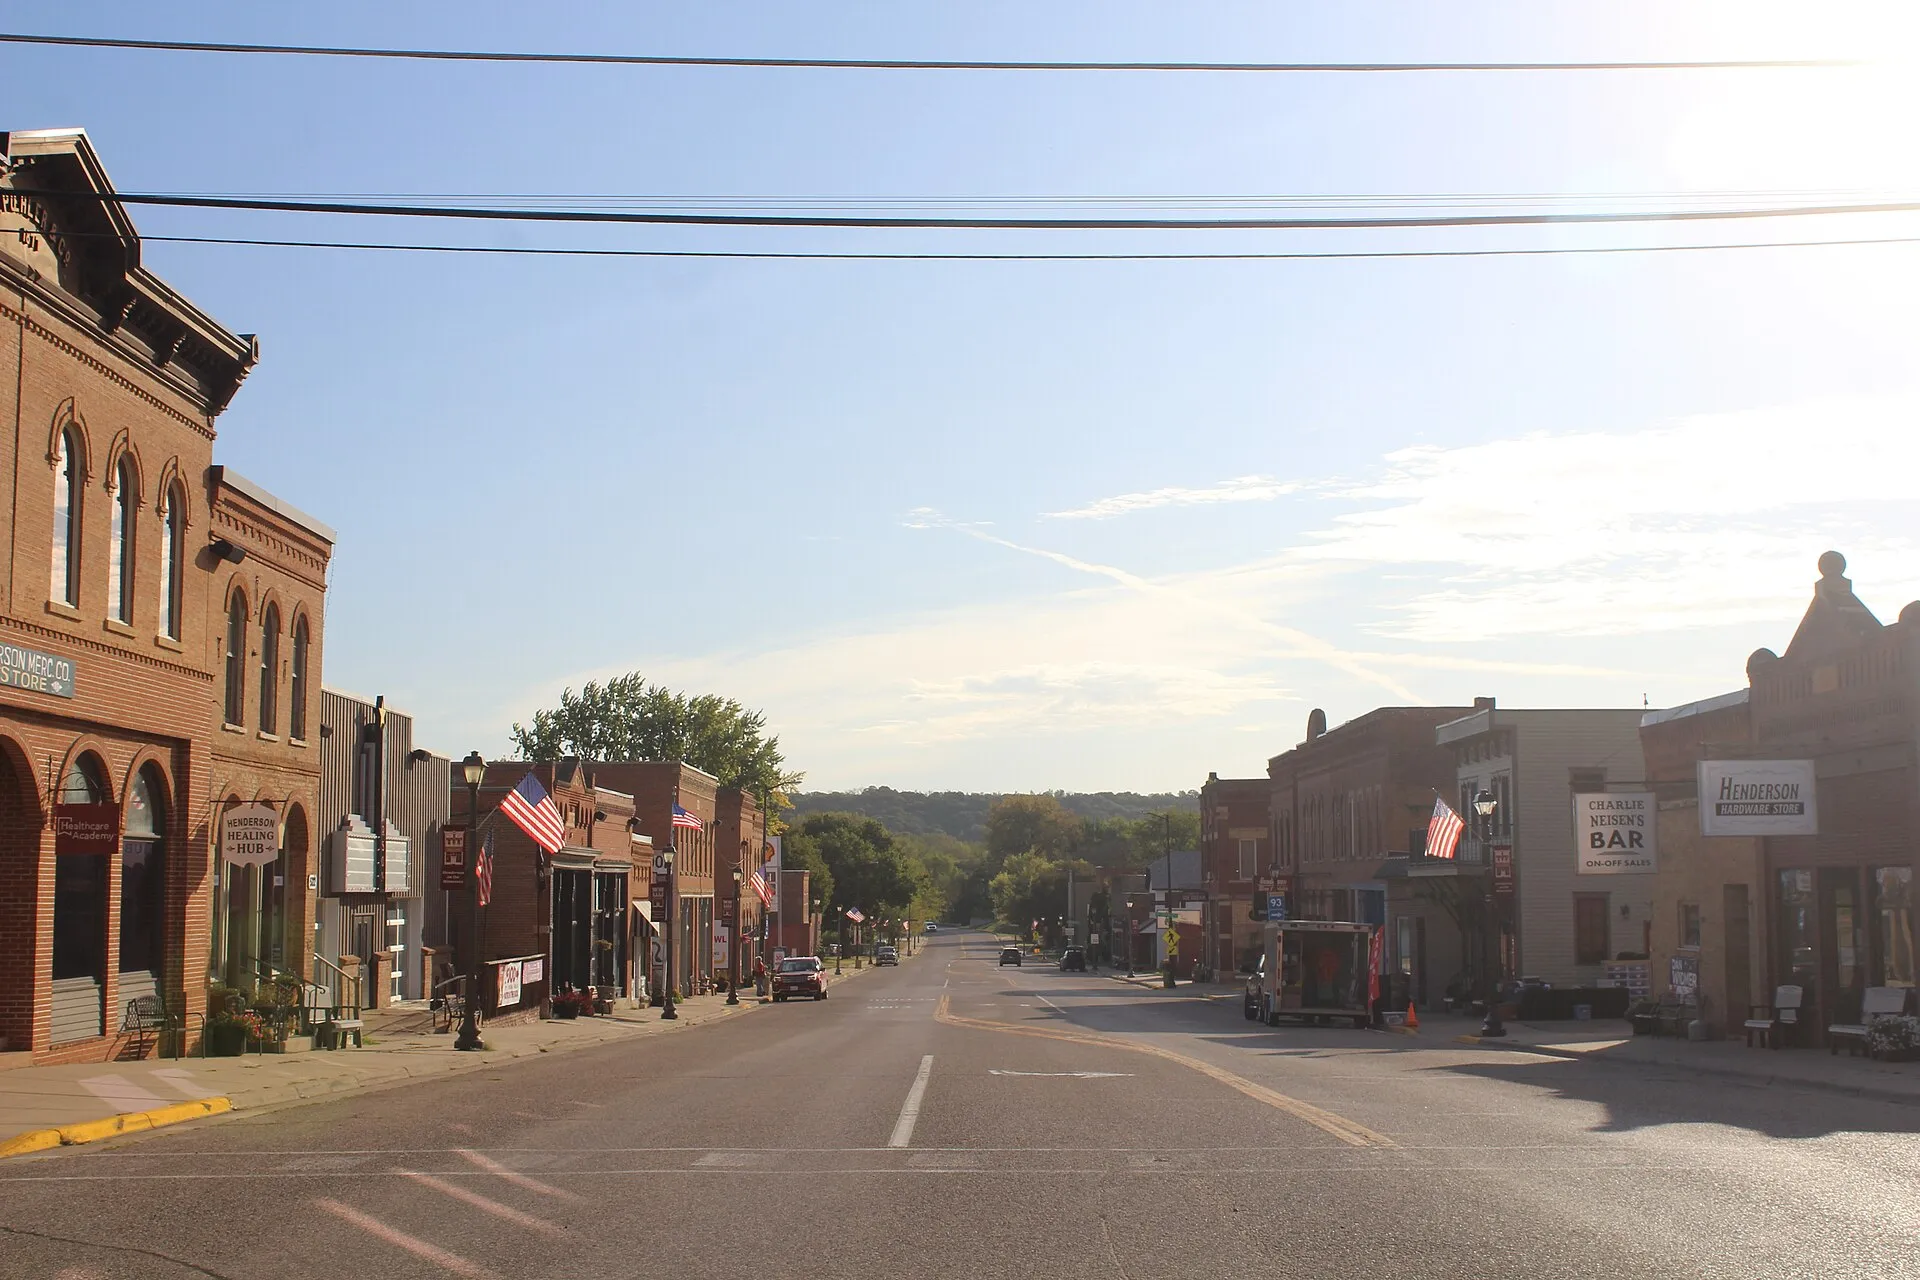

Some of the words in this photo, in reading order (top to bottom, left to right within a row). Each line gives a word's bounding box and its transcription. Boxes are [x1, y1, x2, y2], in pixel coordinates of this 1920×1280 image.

[28, 652, 54, 677] MERC.
[55, 661, 71, 682] CO.
[0, 666, 47, 691] STORE
[1720, 777, 1799, 800] HENDERSON
[1589, 800, 1645, 810] CHARLIE
[1721, 803, 1771, 815] HARDWARE
[1772, 803, 1800, 814] STORE
[61, 821, 110, 831] Healthcare
[227, 817, 275, 828] HENDERSON
[1590, 814, 1645, 827] NEISEN'S
[72, 831, 114, 842] Academy
[227, 831, 274, 841] HEALING
[1590, 829, 1645, 849] BAR
[236, 843, 264, 853] HUB
[1586, 860, 1623, 868] ON-OFF
[1270, 898, 1282, 907] 93
